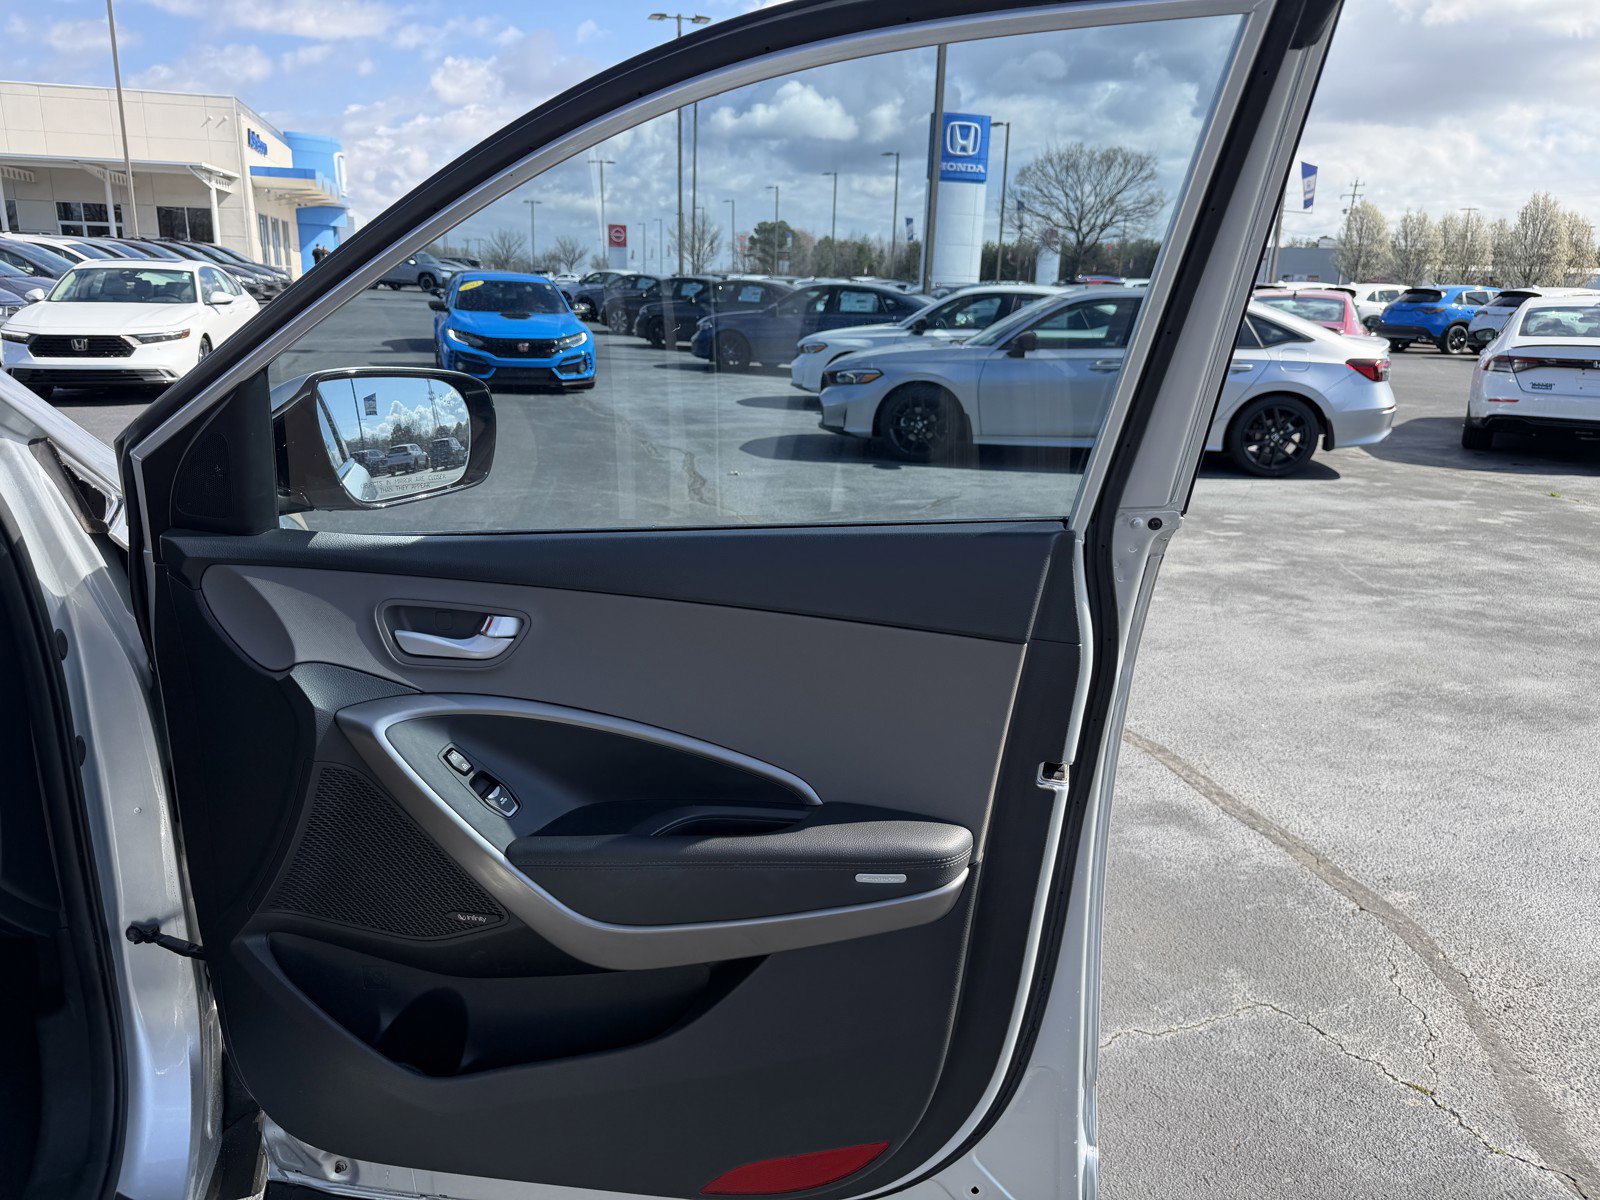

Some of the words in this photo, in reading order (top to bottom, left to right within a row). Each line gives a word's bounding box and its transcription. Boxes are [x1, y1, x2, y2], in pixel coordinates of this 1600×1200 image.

[360, 481, 383, 489] OBJECTS
[394, 476, 413, 484] MIRROR
[428, 473, 447, 481] CLOSER
[411, 482, 431, 490] APPEAR
